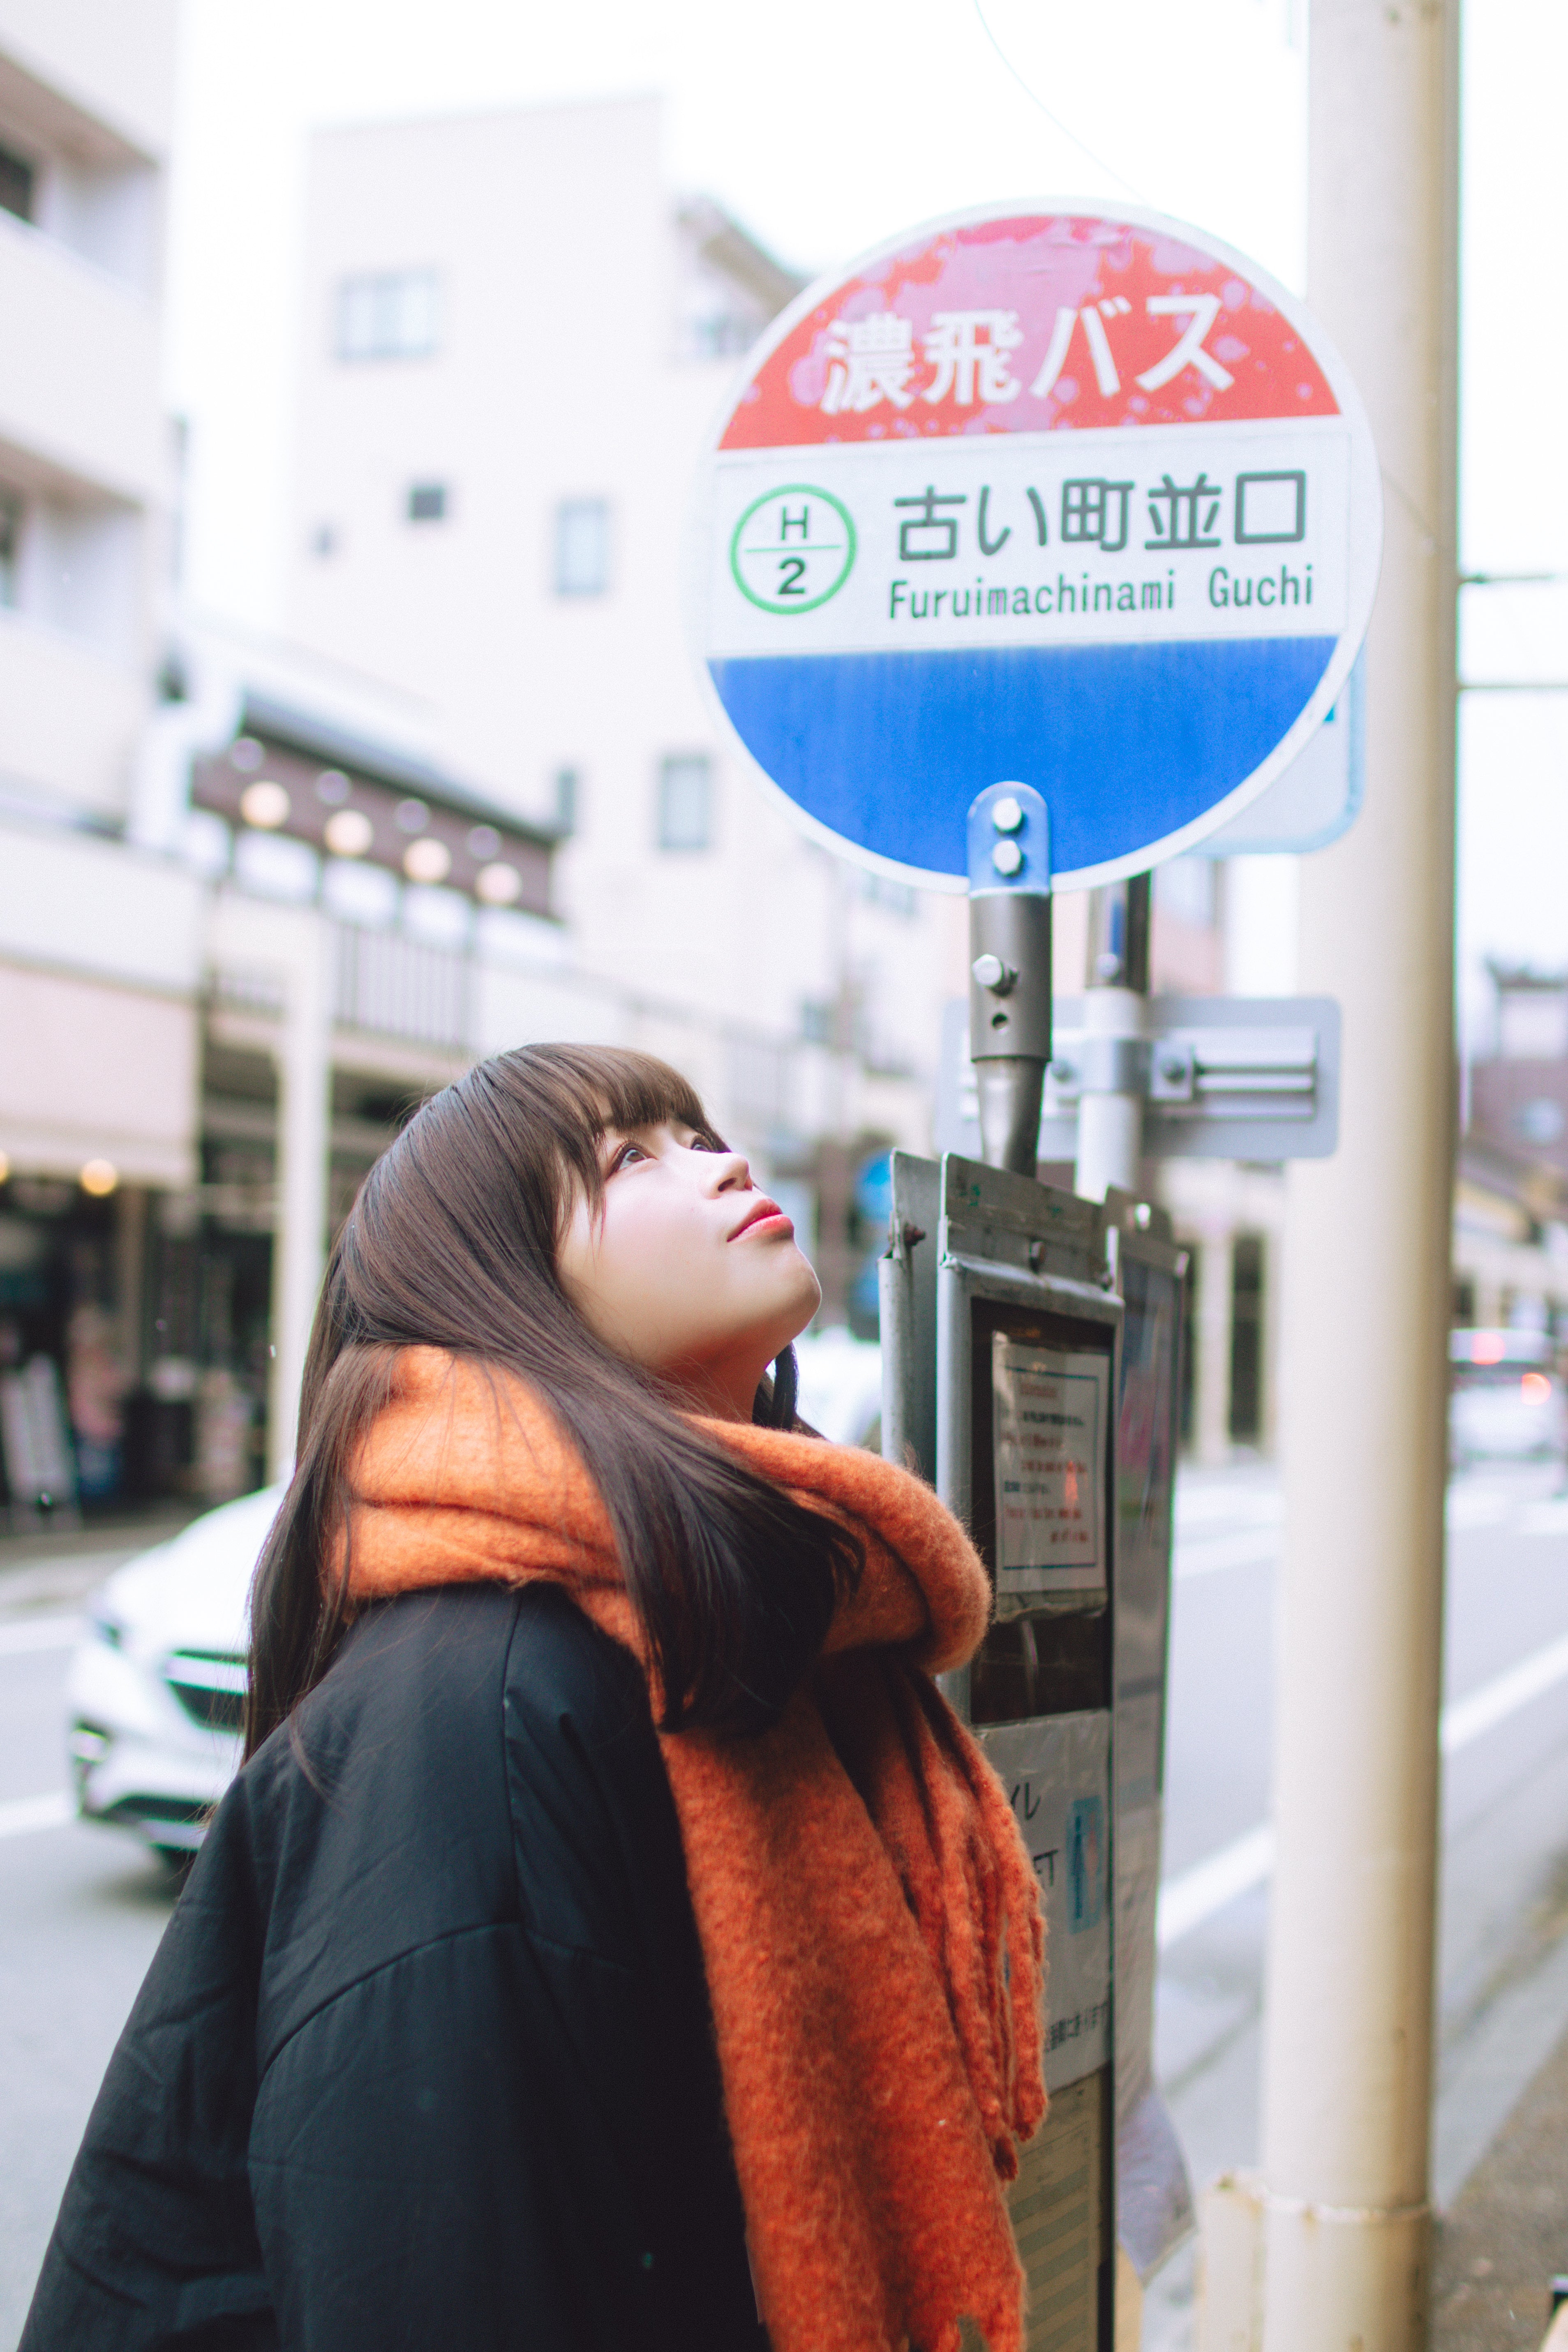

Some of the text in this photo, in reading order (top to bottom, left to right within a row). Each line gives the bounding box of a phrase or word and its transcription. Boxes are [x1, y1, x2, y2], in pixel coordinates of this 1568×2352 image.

[822, 292, 1235, 415] 濃飛バス
[779, 505, 810, 541] H
[894, 470, 1306, 561] 古い町並口
[777, 557, 807, 596] 2
[889, 563, 1314, 620] Furuimachinami Guchi
